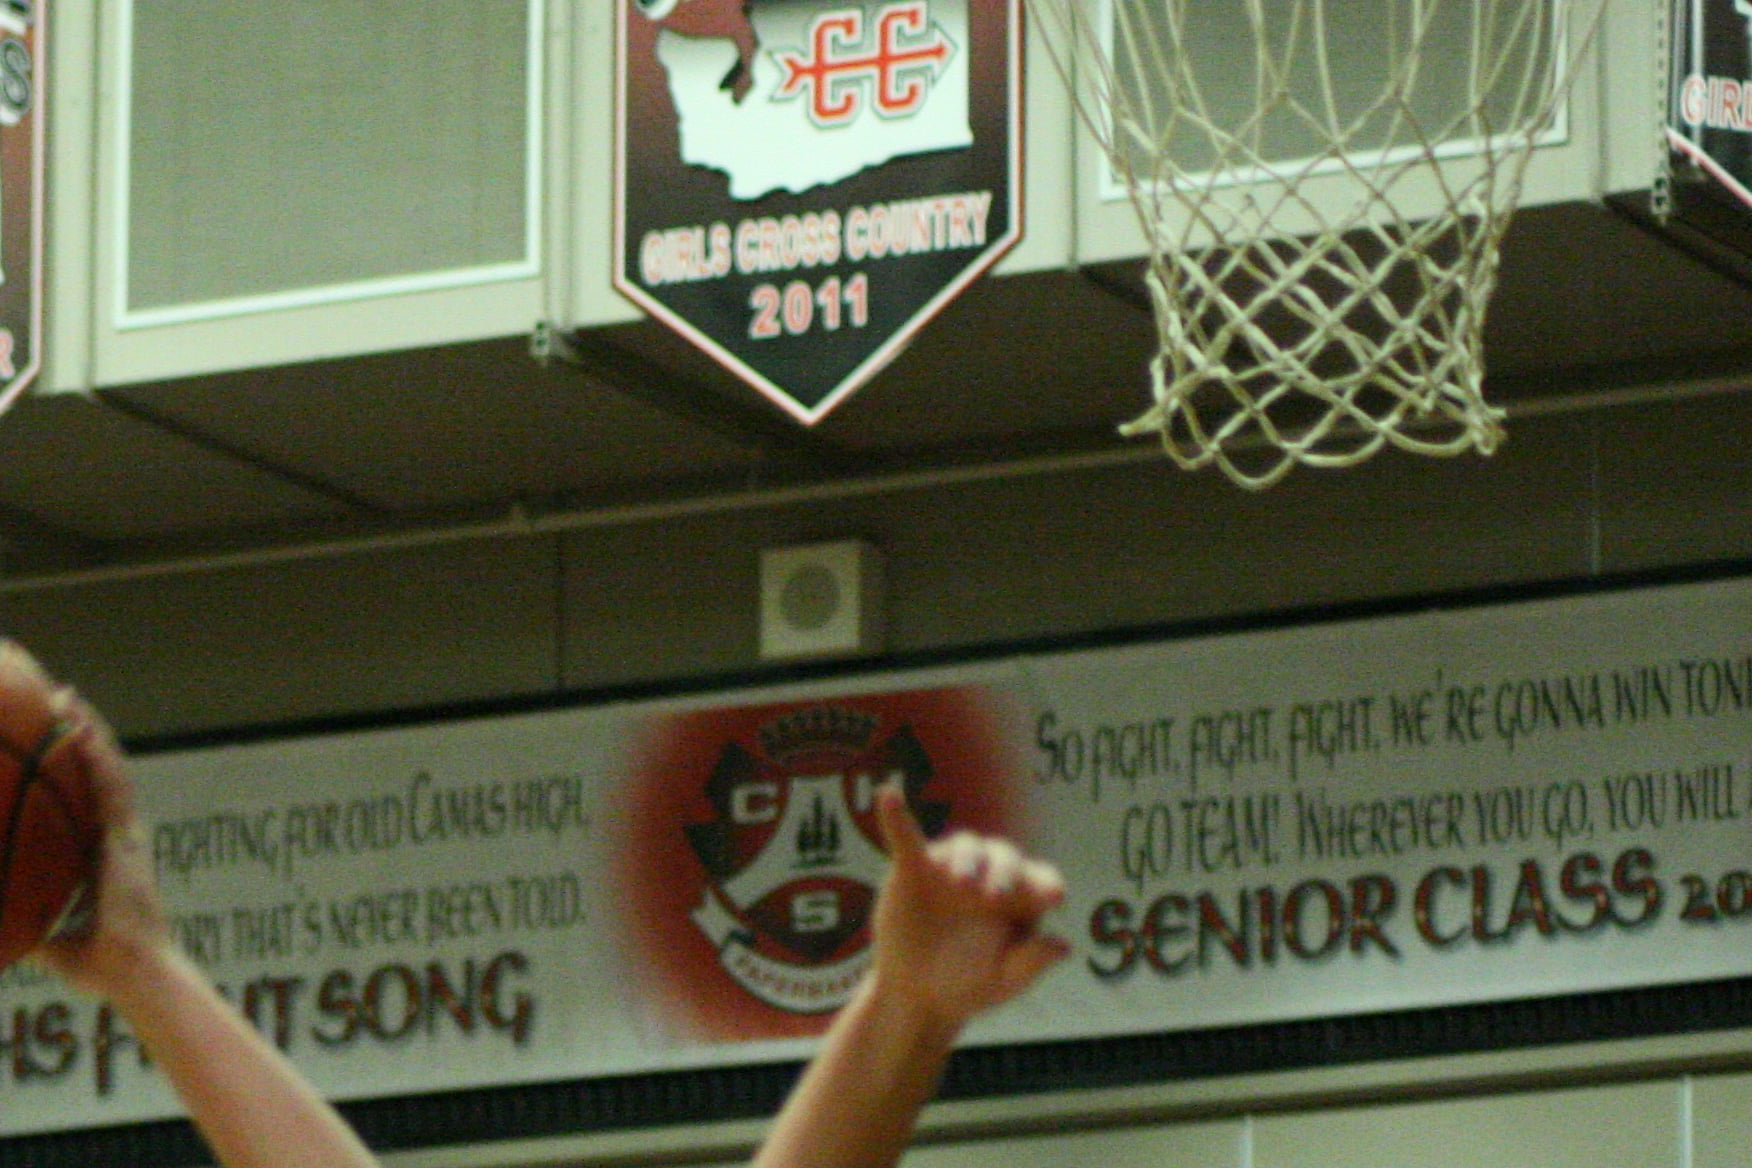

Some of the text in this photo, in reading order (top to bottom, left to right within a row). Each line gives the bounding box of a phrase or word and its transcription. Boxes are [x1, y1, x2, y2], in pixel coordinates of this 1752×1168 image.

[640, 194, 993, 286] GIRLS CROSS COUNTRY
[750, 275, 869, 341] 2011
[1494, 677, 1606, 752] GONNA
[1610, 670, 1673, 724] WIN
[1294, 790, 1466, 860] WHEREVER
[1602, 774, 1670, 832] YOU
[1674, 768, 1740, 823] WILL
[1086, 877, 1401, 983] SENIOR
[1412, 850, 1664, 947] CLASS
[312, 954, 532, 1048] SONG
